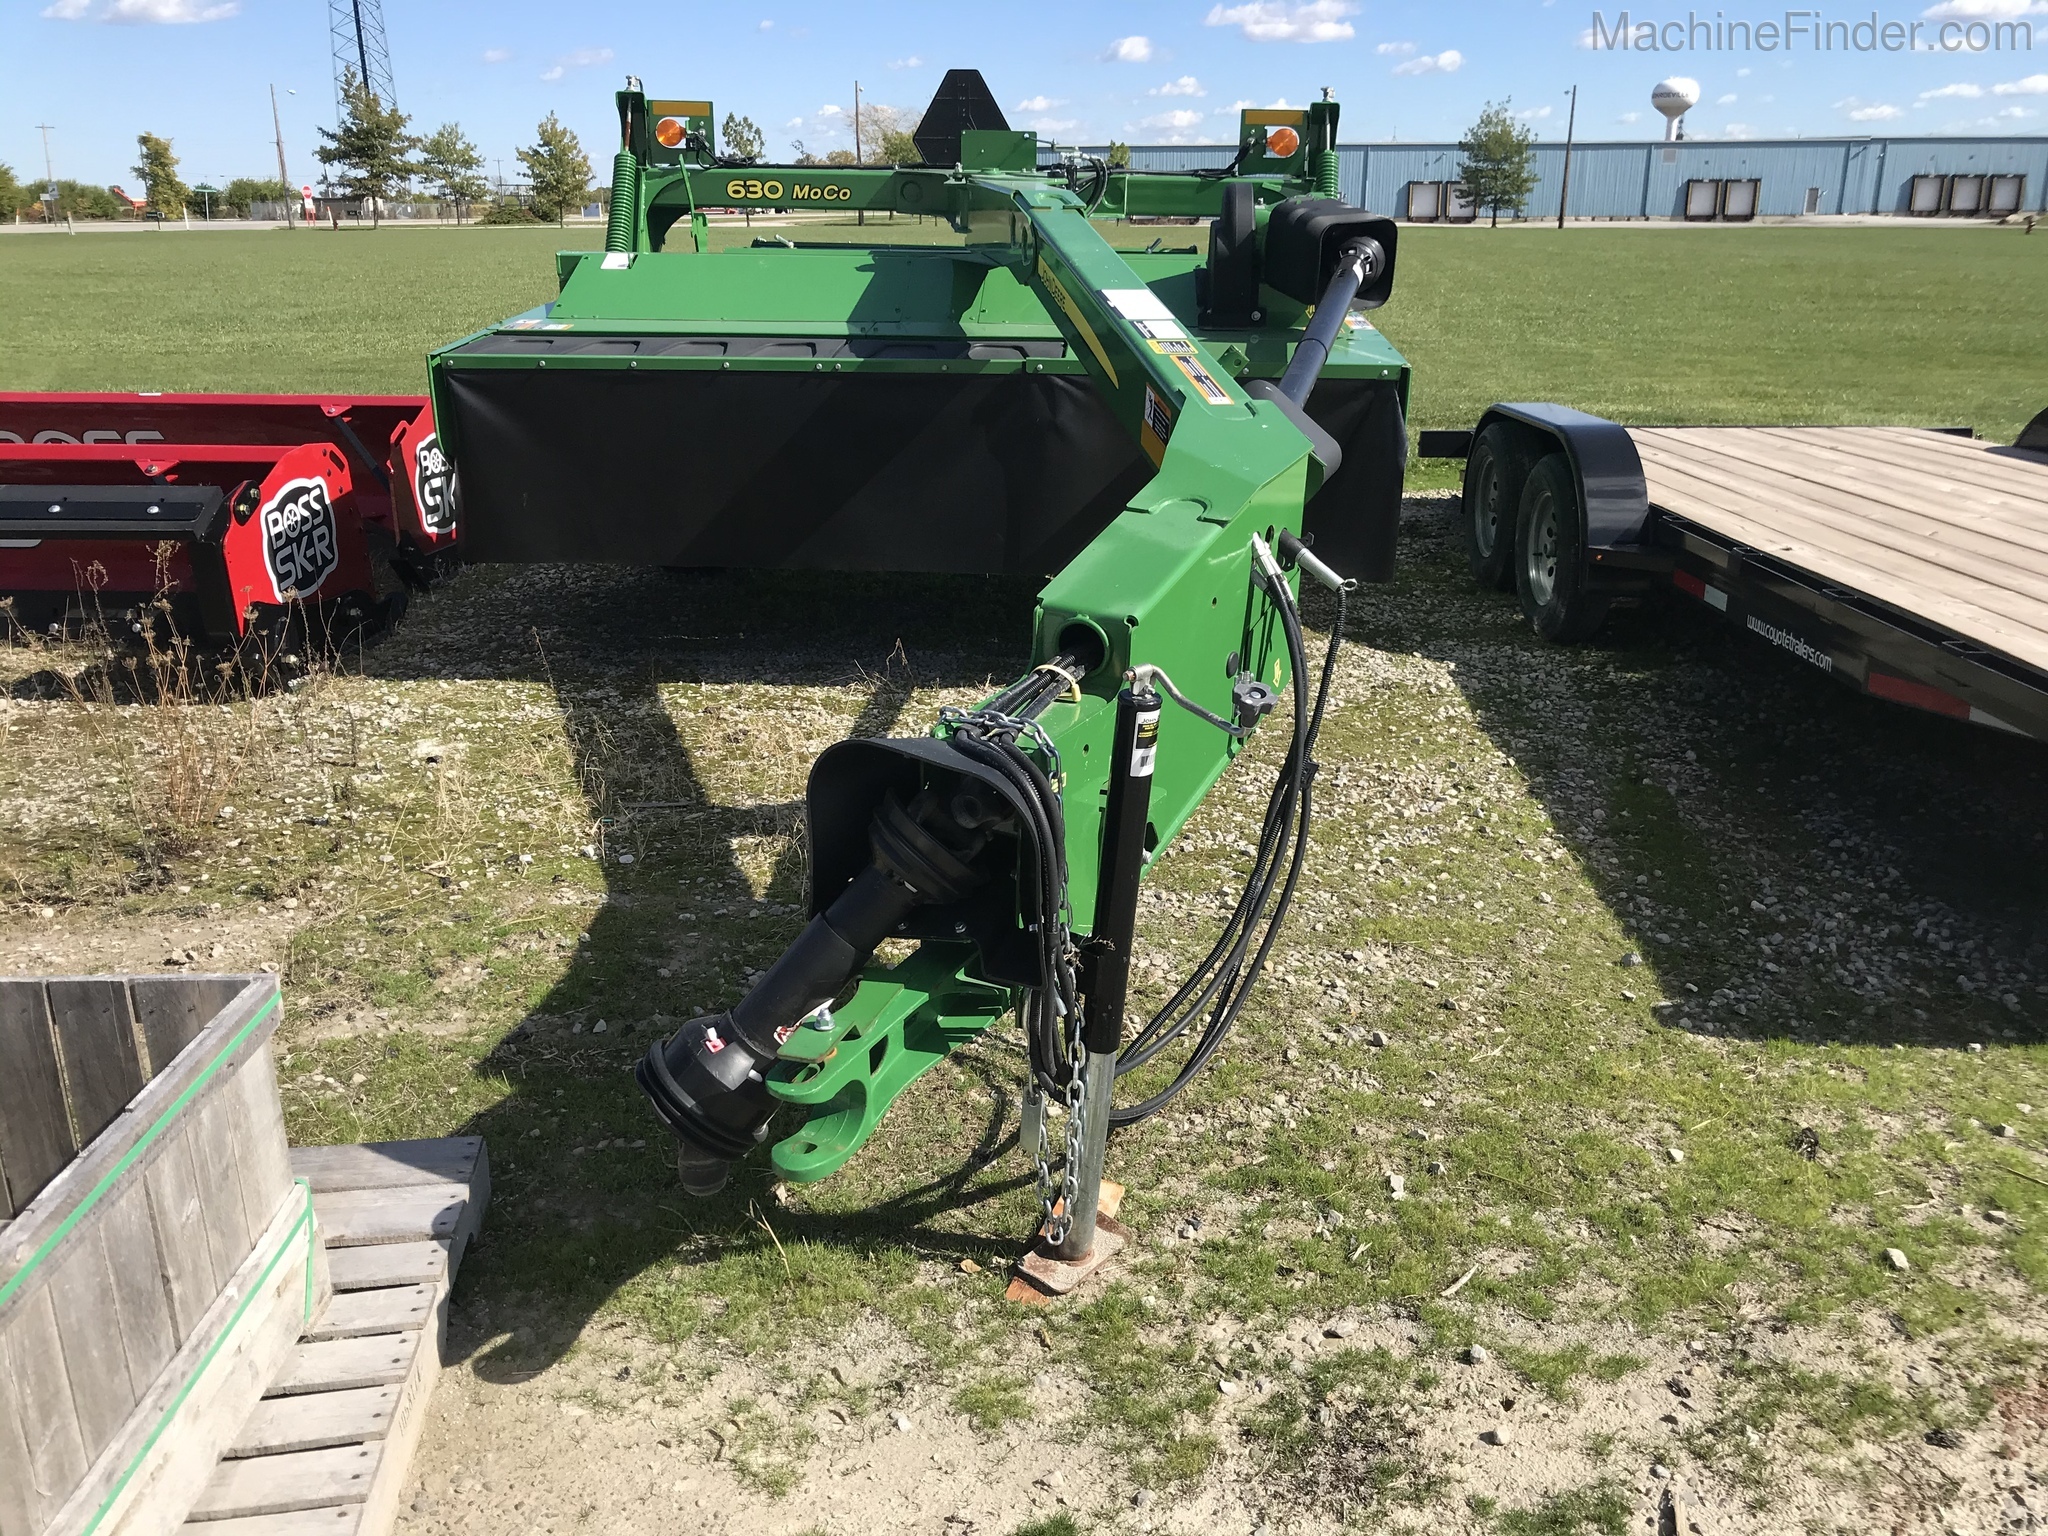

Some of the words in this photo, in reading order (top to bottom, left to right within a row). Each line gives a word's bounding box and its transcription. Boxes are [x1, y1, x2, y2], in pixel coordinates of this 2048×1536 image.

[727, 180, 784, 200] 630
[792, 184, 851, 200] MoCo
[267, 487, 325, 550] BOSS
[424, 476, 456, 525] SK
[275, 525, 334, 592] SK-R
[1746, 614, 1833, 673] www.coyotetrailers.com
